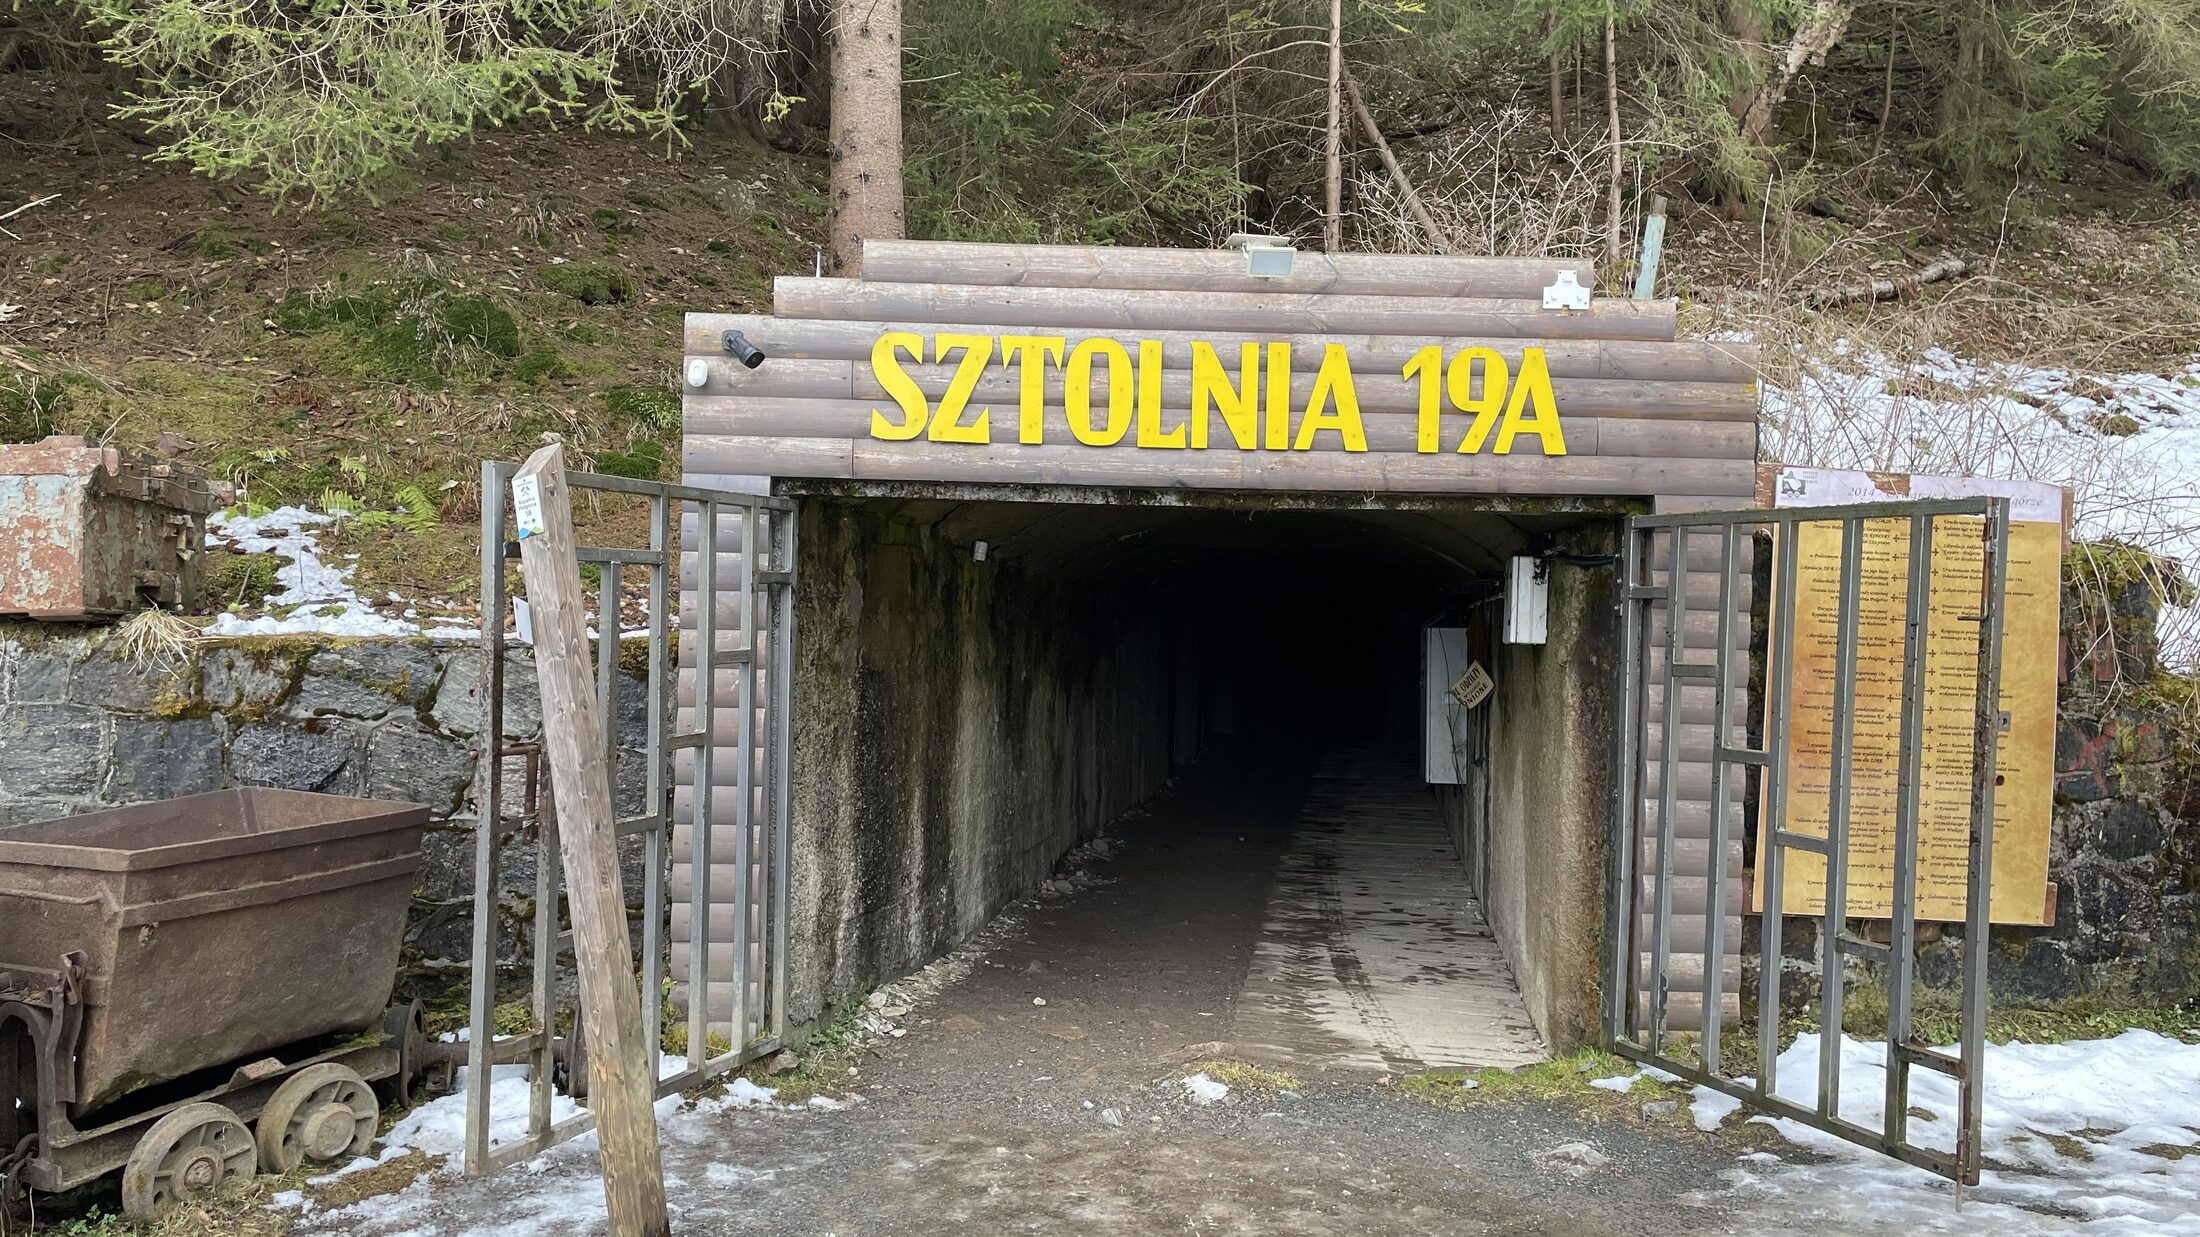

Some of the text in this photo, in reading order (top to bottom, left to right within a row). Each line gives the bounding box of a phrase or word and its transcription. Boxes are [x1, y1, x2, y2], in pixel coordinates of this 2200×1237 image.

[870, 331, 1567, 456] SZTOLNIA 19A
[1848, 486, 1874, 497] 2014
